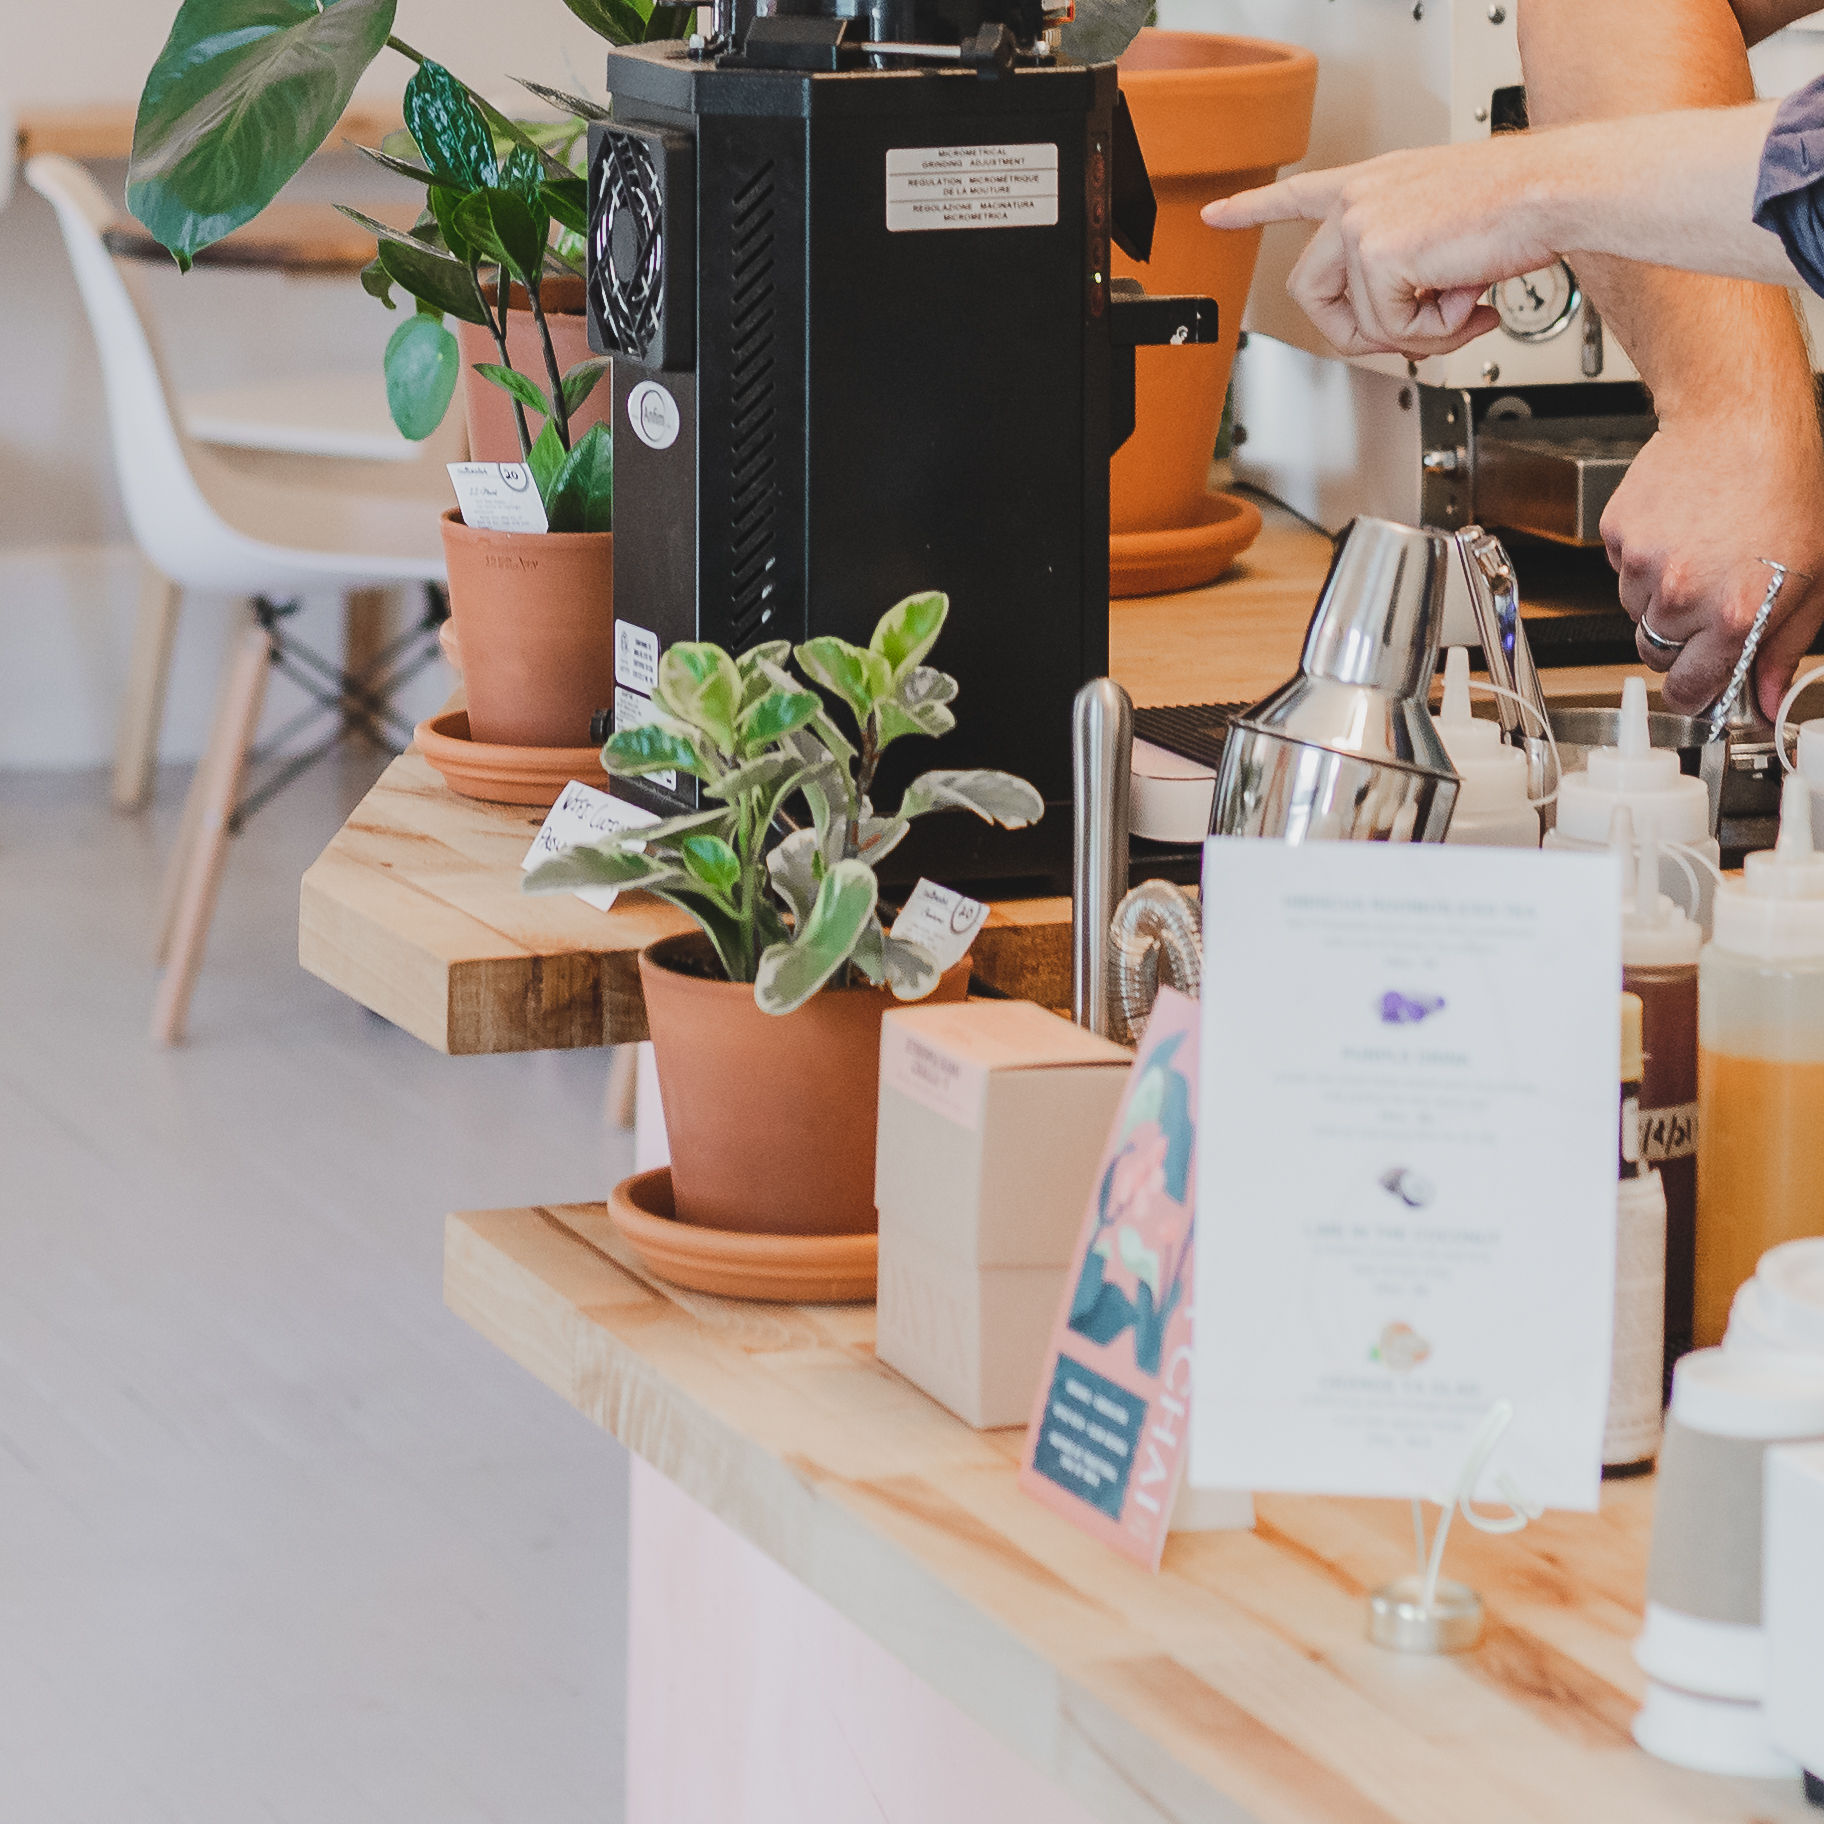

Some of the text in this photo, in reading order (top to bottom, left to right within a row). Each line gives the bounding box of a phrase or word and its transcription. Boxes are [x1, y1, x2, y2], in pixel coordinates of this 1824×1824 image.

[938, 148, 1006, 157] MICROMETRICAL
[921, 157, 1025, 169] GRINDING ADJUSTMENT
[943, 186, 1010, 195] DE LA MOUTURE
[912, 201, 1035, 212] REGOLAZIONE MACINATURA
[943, 212, 1008, 221] MICROMETRICA
[503, 468, 520, 481] 20
